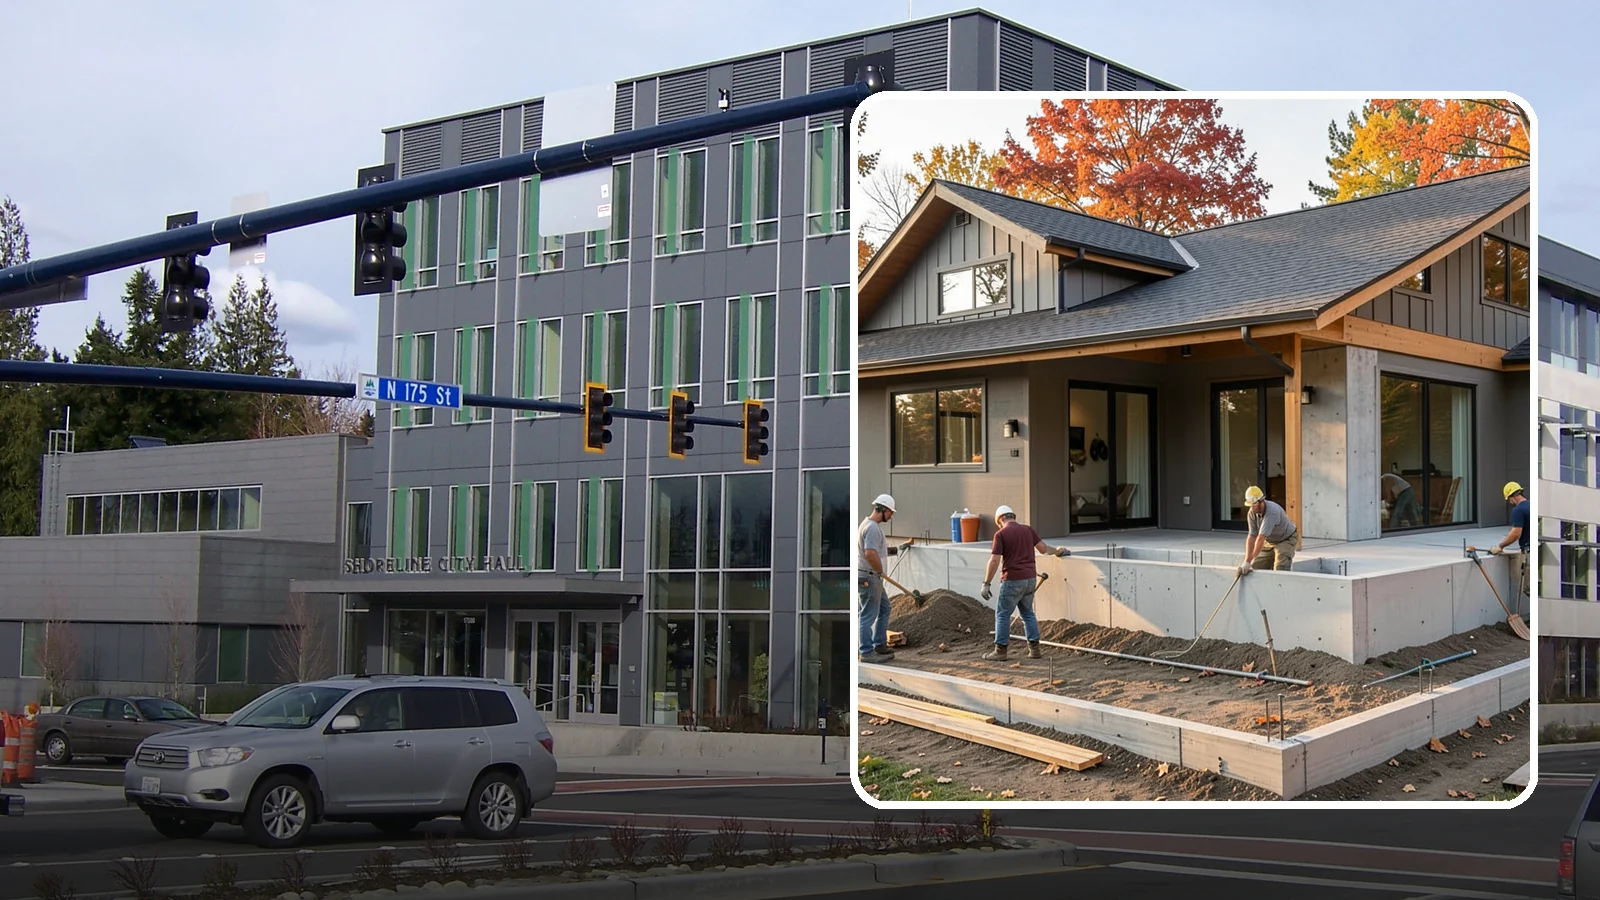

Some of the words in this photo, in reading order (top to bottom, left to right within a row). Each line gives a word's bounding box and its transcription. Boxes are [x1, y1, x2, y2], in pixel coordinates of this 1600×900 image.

[387, 380, 396, 400] N
[405, 382, 428, 403] 175
[436, 386, 452, 406] St
[344, 556, 432, 574] SHORELINE
[438, 555, 476, 573] CITY
[483, 555, 526, 572] HALL
